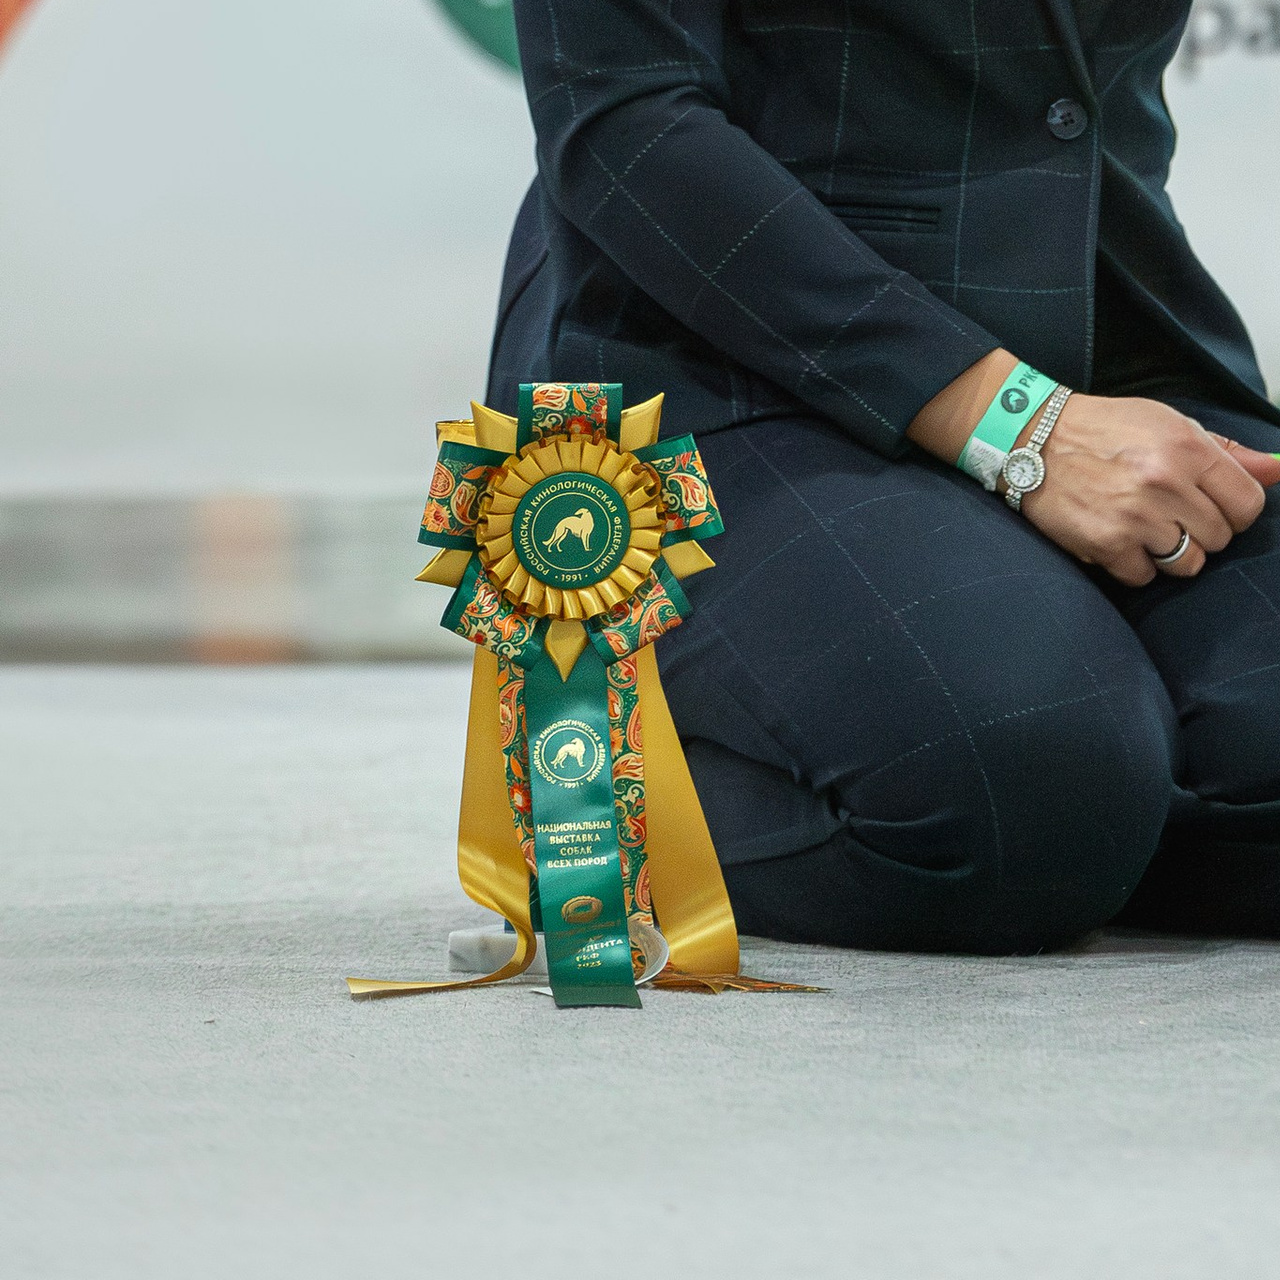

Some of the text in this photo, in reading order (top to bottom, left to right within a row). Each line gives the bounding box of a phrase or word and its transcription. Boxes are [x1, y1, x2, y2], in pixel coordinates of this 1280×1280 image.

[520, 481, 622, 576] РОССИЙСКАЯ КИНОЛОГИЧЕСКАЯ ФЕДЕРАЦИЯ
[561, 573, 582, 582] 1991
[537, 820, 611, 833] НАЦИОНАЛЬНАЯ
[549, 833, 601, 845] ВЫСТАВКА
[559, 845, 592, 856] СОБАК
[547, 856, 608, 868] ВСЕХ ПОРОД
